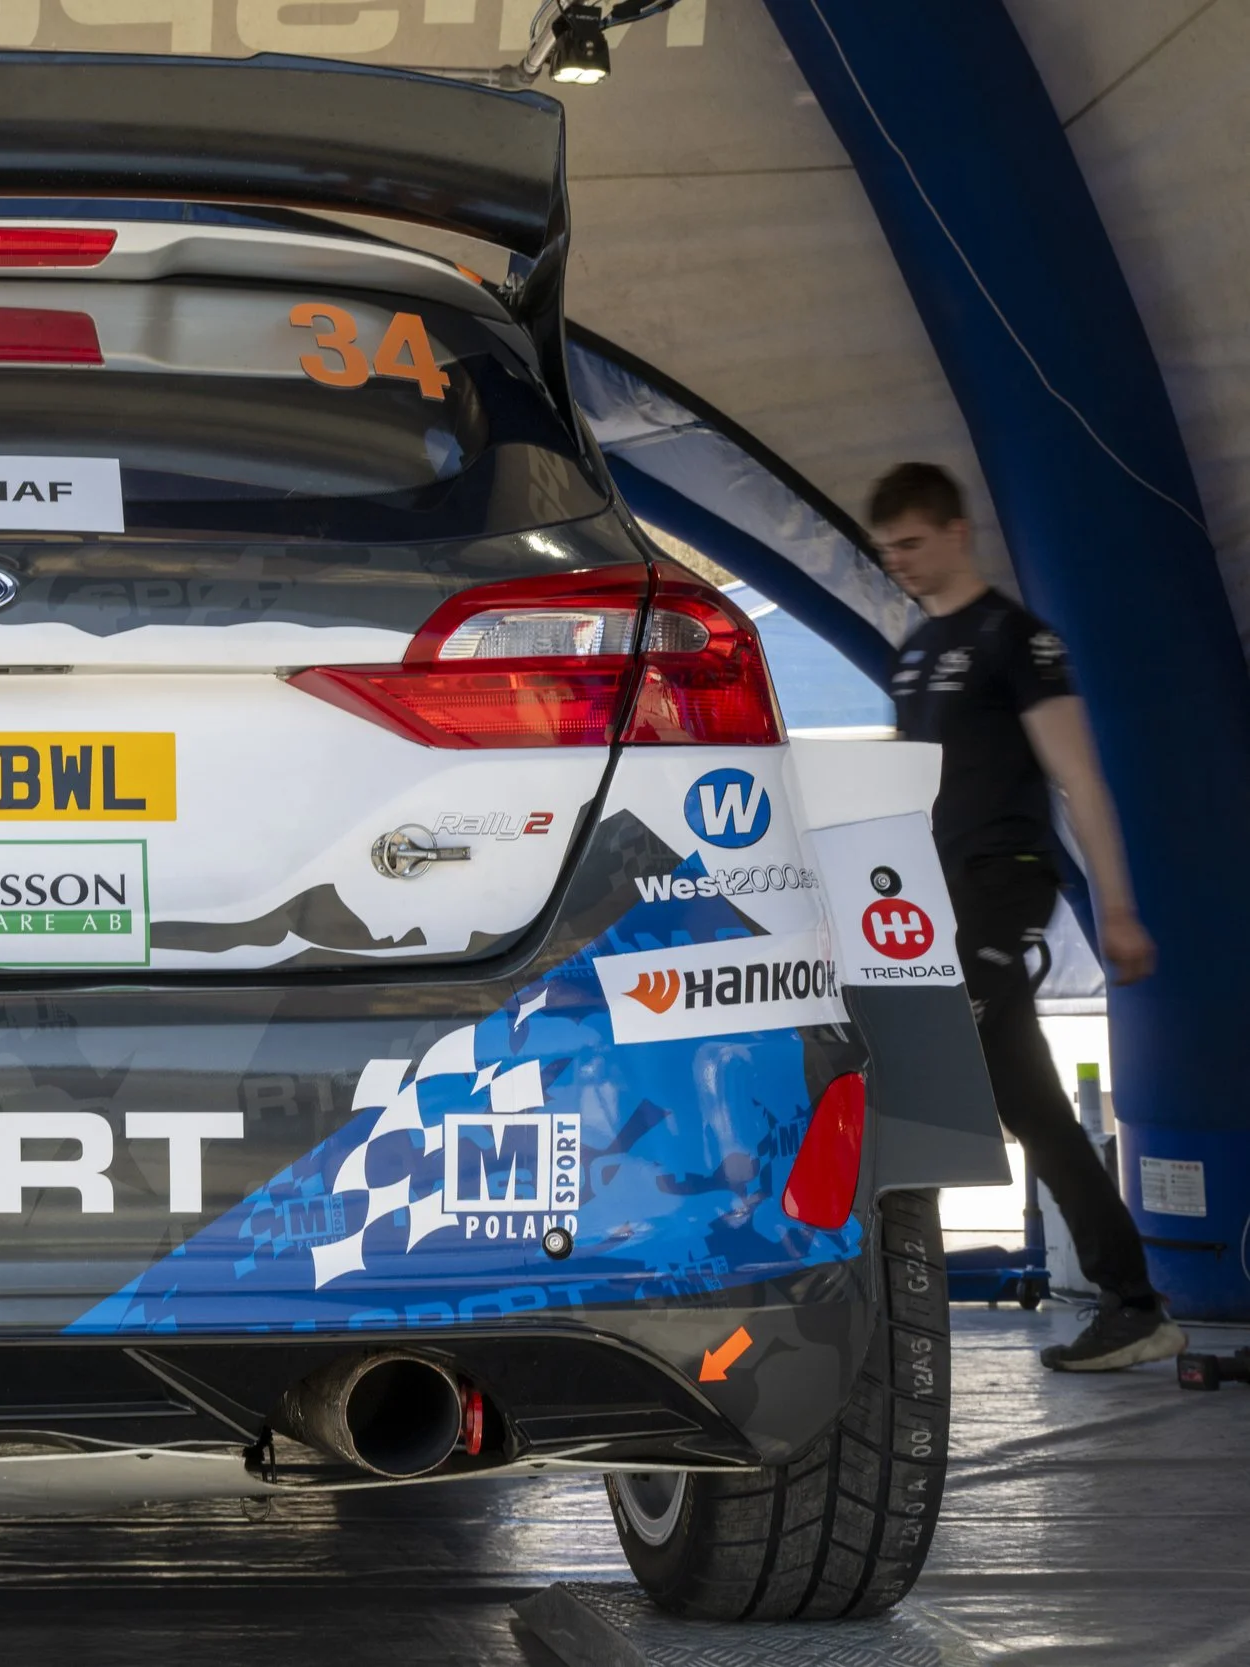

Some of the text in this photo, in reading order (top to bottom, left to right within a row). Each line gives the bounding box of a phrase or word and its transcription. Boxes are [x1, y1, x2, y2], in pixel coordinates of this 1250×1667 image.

[289, 302, 451, 402] 34
[432, 811, 554, 841] Rally2
[698, 779, 764, 837] W
[82, 913, 123, 931] AB
[860, 965, 956, 980] TRENDAB
[457, 1124, 539, 1201] M
[555, 1121, 577, 1203] SPORT
[465, 1214, 578, 1239] POLAND
